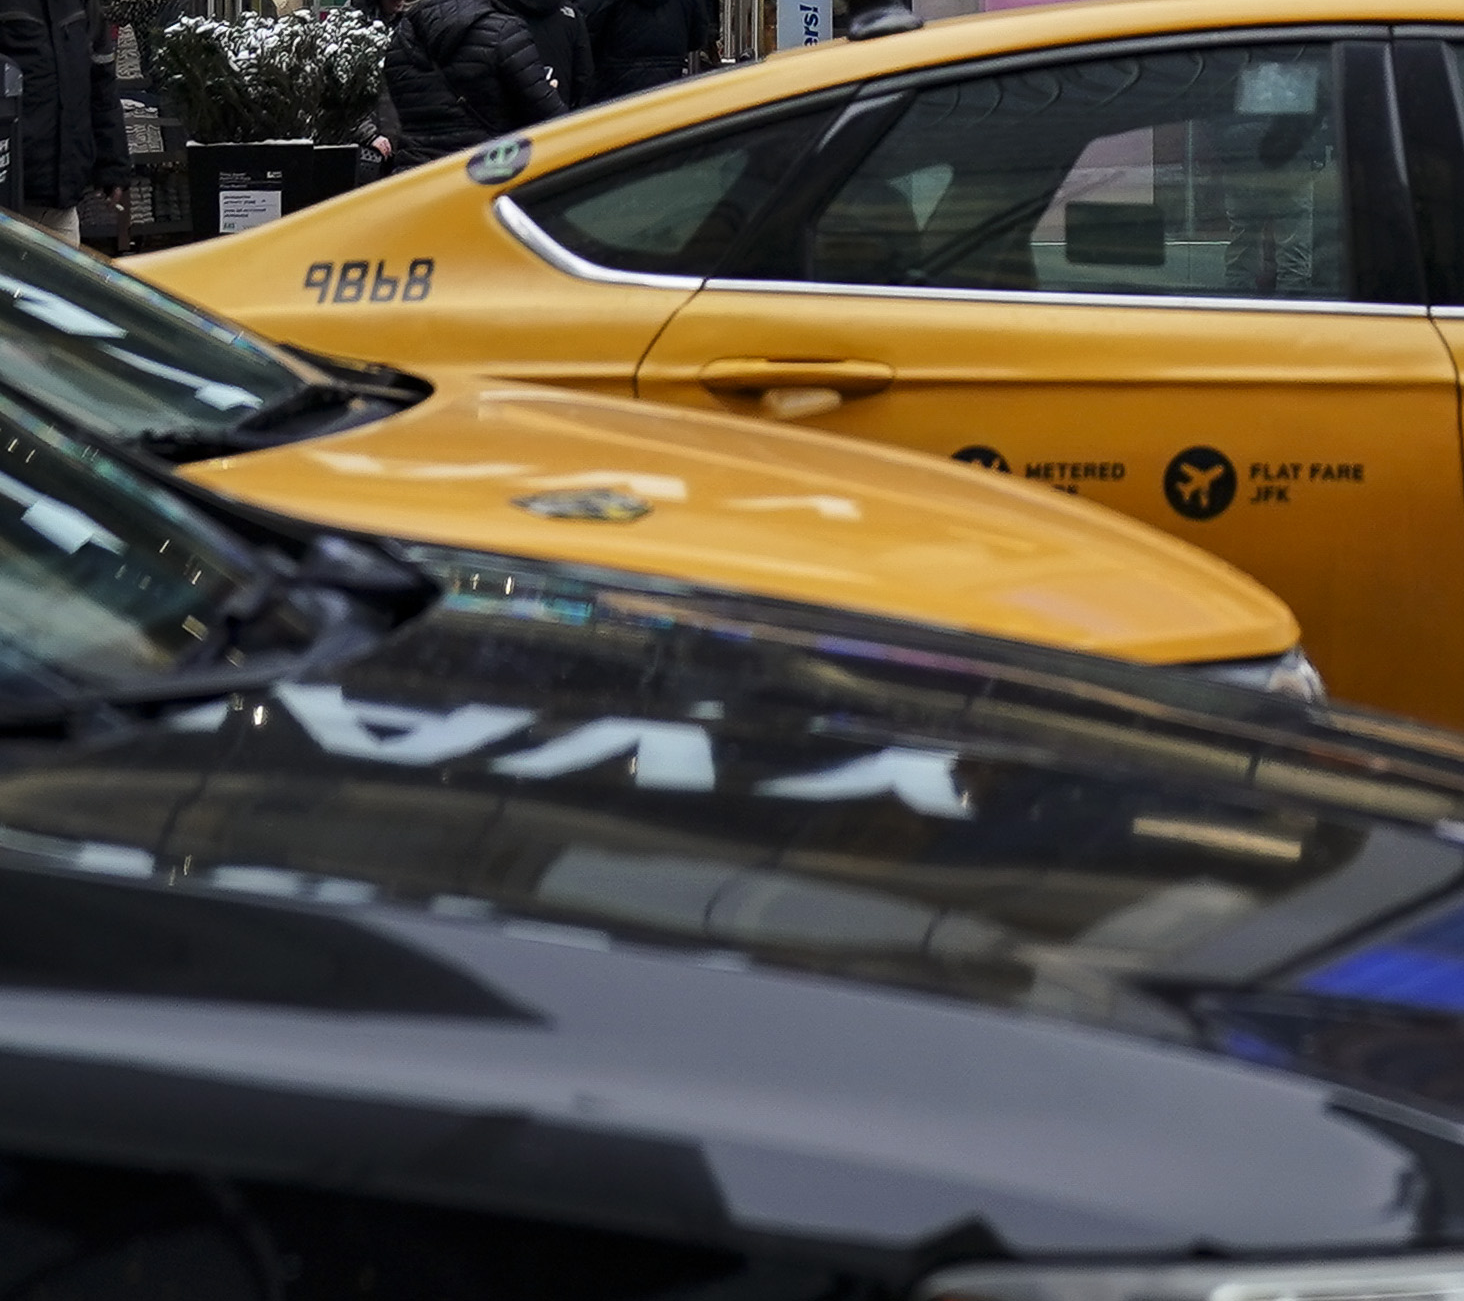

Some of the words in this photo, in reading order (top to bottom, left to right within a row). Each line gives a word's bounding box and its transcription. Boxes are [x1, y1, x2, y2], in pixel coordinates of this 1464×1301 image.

[1024, 462, 1126, 481] METERED
[1249, 462, 1303, 481] FLAT
[1309, 462, 1365, 481] FARE
[1249, 486, 1289, 504] JFK
